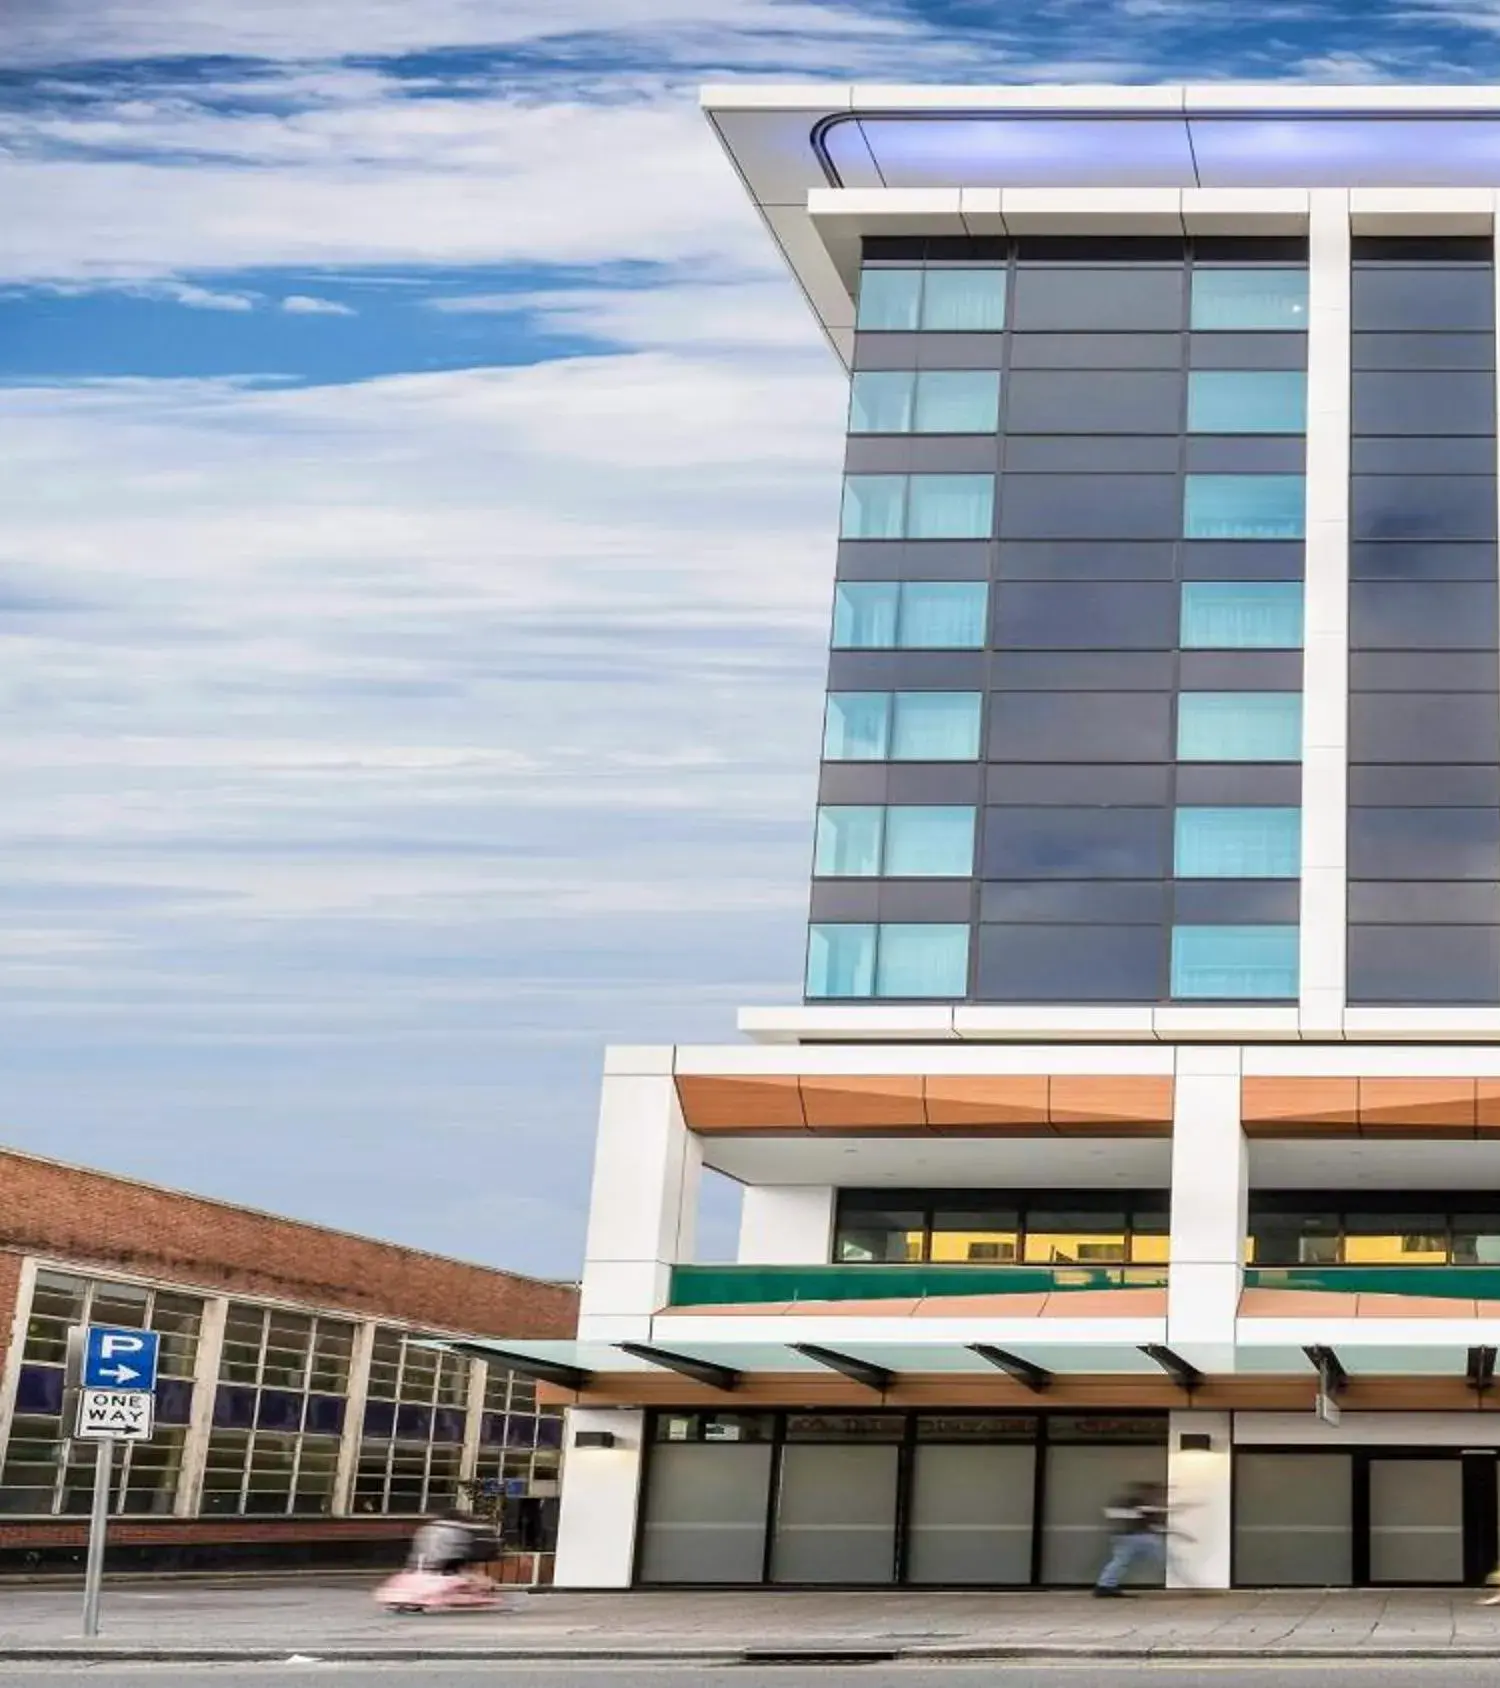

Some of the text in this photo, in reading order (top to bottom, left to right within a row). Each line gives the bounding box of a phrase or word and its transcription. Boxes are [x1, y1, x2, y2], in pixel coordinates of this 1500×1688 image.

[102, 1335, 144, 1358] P
[93, 1394, 142, 1409] ONE
[89, 1409, 144, 1422] WAY
